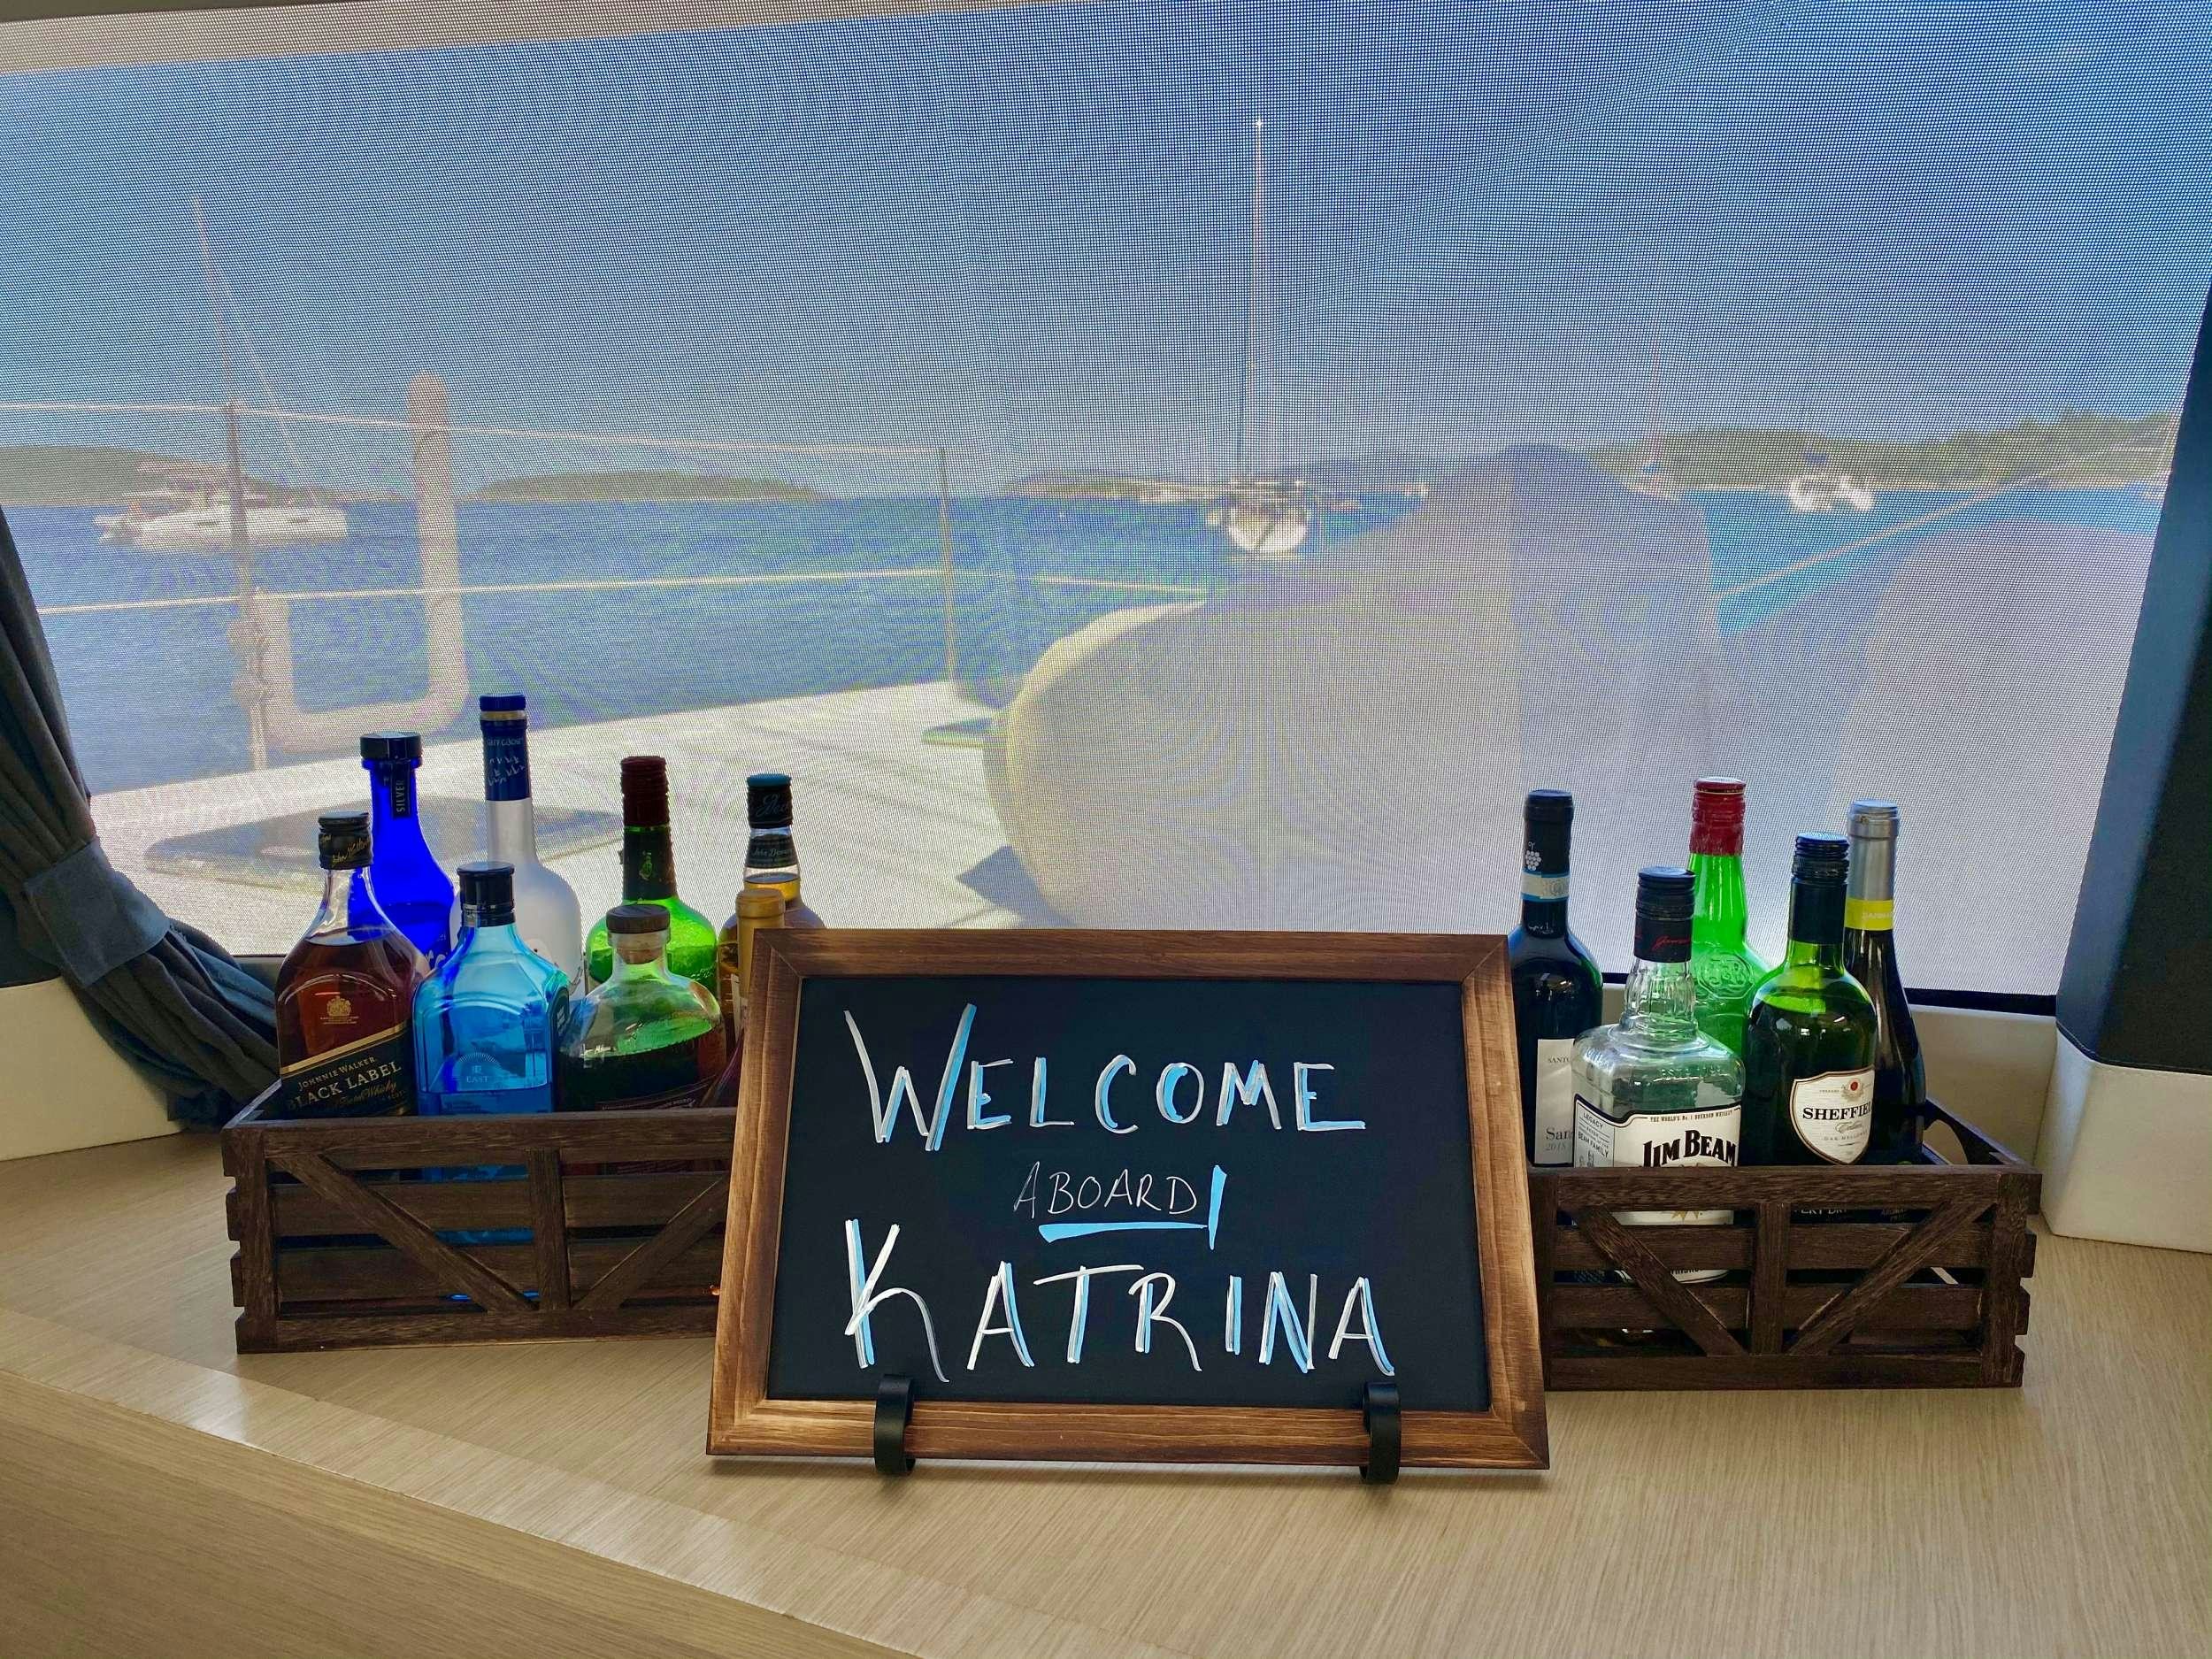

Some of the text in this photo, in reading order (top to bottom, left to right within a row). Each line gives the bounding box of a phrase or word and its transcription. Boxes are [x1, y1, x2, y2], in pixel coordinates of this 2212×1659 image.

[396, 779, 405, 813] SILVER
[288, 1060, 403, 1110] BLACK LABEL
[297, 1056, 376, 1092] JOHNNIE WALKER
[844, 1002, 1366, 1151] WELCOME
[1643, 1138, 1681, 1167] JIM
[1683, 1129, 1737, 1167] BEAM
[844, 1218, 1396, 1383] KATRINA
